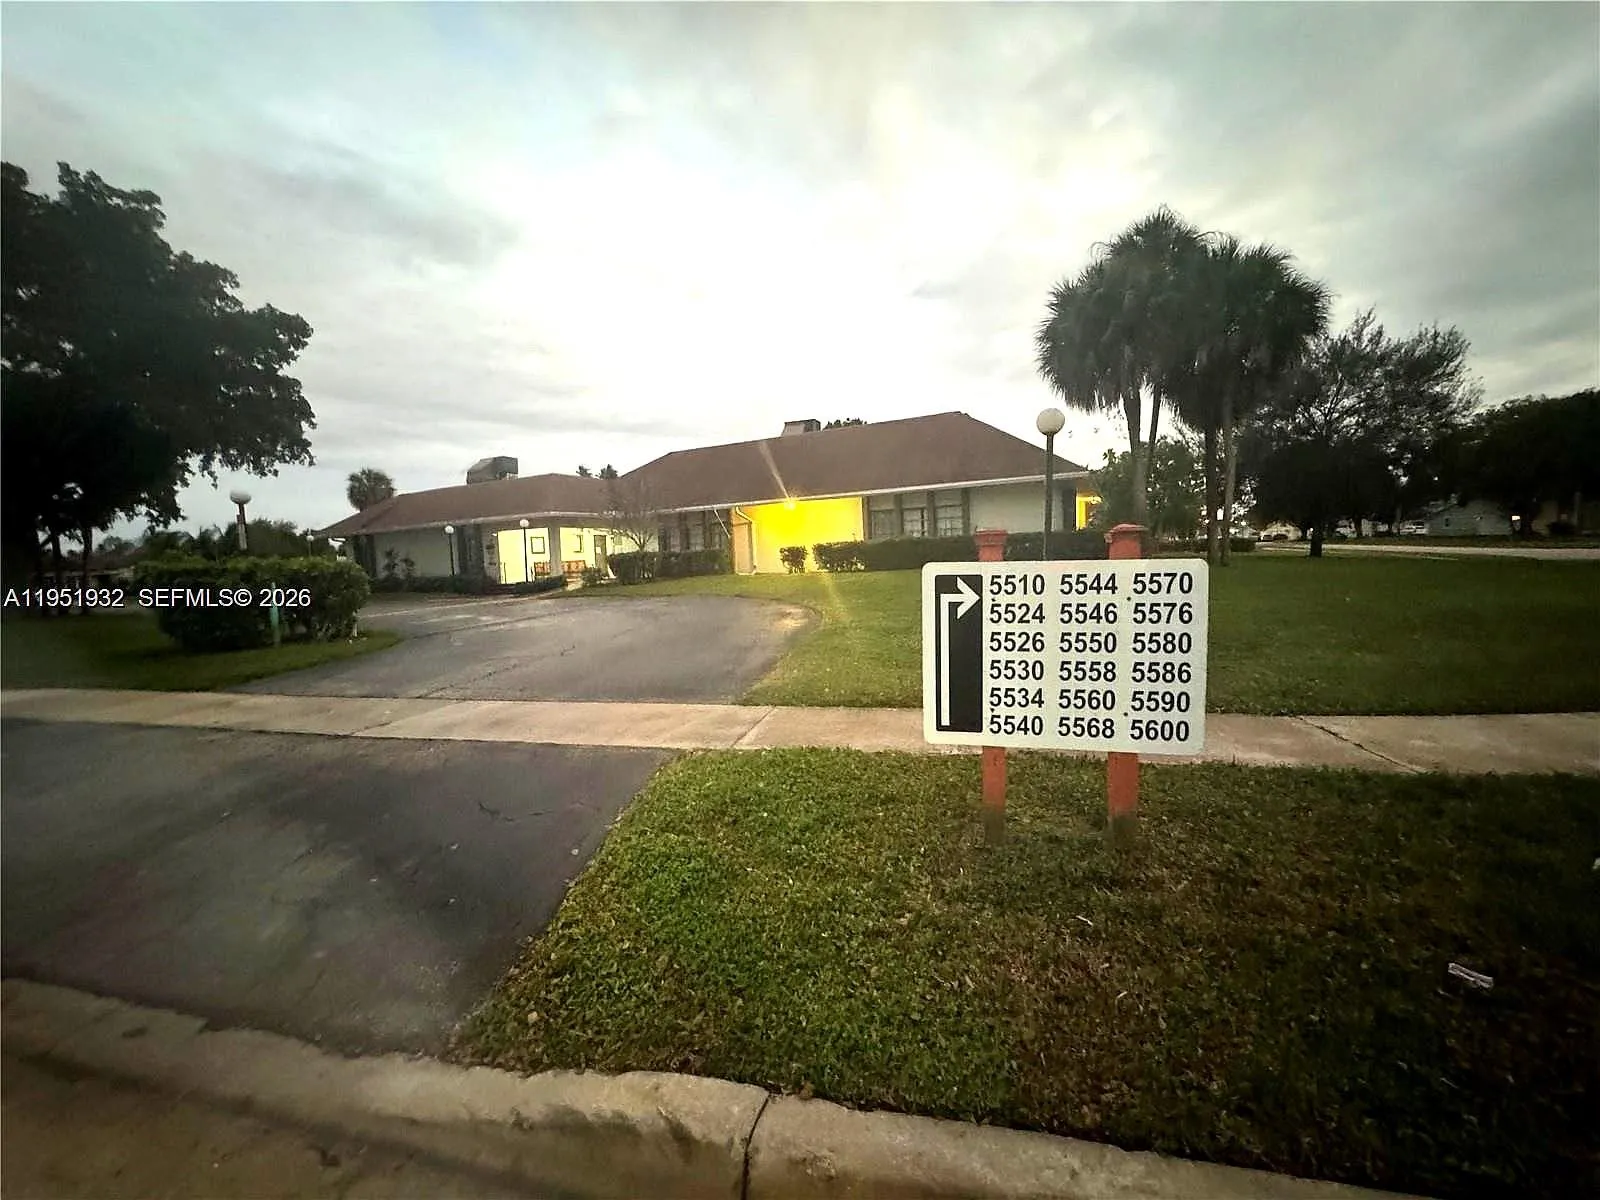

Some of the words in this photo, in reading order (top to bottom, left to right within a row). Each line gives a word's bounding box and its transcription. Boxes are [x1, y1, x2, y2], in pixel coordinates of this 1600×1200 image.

[989, 574, 1045, 596] 5510
[1059, 573, 1118, 595] 5544
[1132, 572, 1193, 595] 5570
[989, 603, 1046, 624] 5524
[1059, 603, 1118, 625] 5546
[1132, 602, 1193, 625] 5576
[989, 631, 1045, 652] 5526
[1058, 632, 1117, 653] 5550
[1131, 632, 1193, 654] 5580
[989, 660, 1045, 681] 5530
[1058, 661, 1117, 682] 5558
[1131, 661, 1192, 684] 5586
[989, 687, 1045, 708] 5534
[1058, 689, 1116, 710] 5560
[1130, 691, 1191, 713] 5590
[989, 715, 1044, 736] 5540
[1057, 717, 1115, 738] 5568
[1129, 720, 1190, 742] 5600
